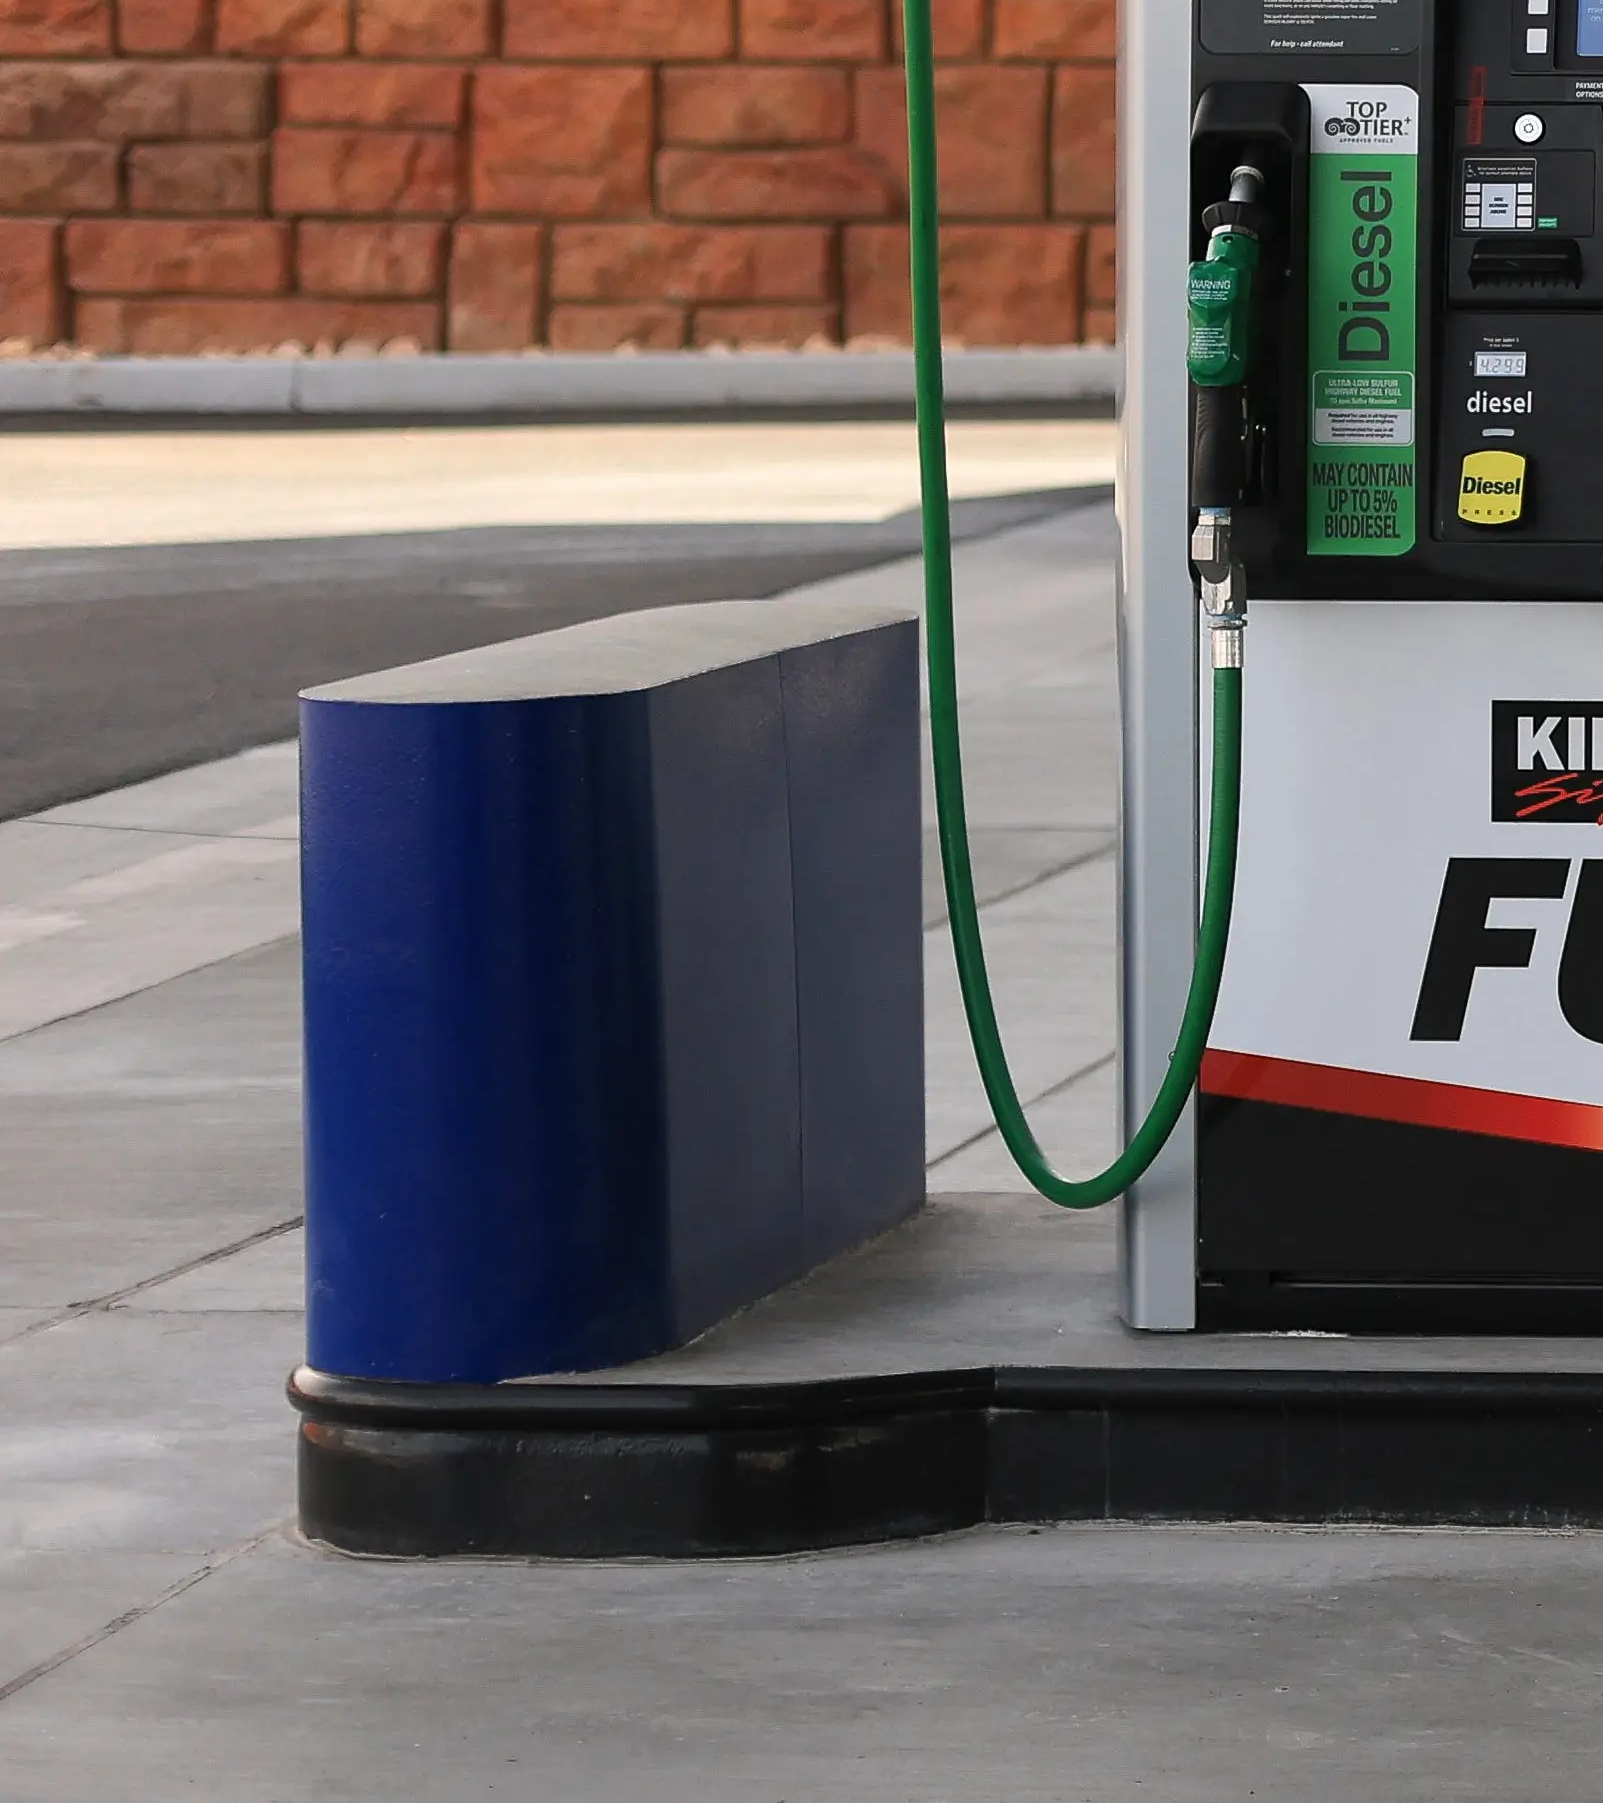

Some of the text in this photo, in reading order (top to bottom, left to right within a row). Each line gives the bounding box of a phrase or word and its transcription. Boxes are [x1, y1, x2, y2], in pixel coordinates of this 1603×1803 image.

[1576, 91, 1603, 99] OPTIONS
[1347, 101, 1388, 116] TOP
[1338, 171, 1393, 361] Diesel
[1191, 279, 1231, 289] WARNING
[1467, 390, 1532, 413] diesel
[1312, 462, 1413, 487] MAY CONTAIN
[1462, 477, 1521, 495] Diesel
[1327, 489, 1398, 513] UP TO 5%
[1324, 515, 1401, 539] BIODIESEL
